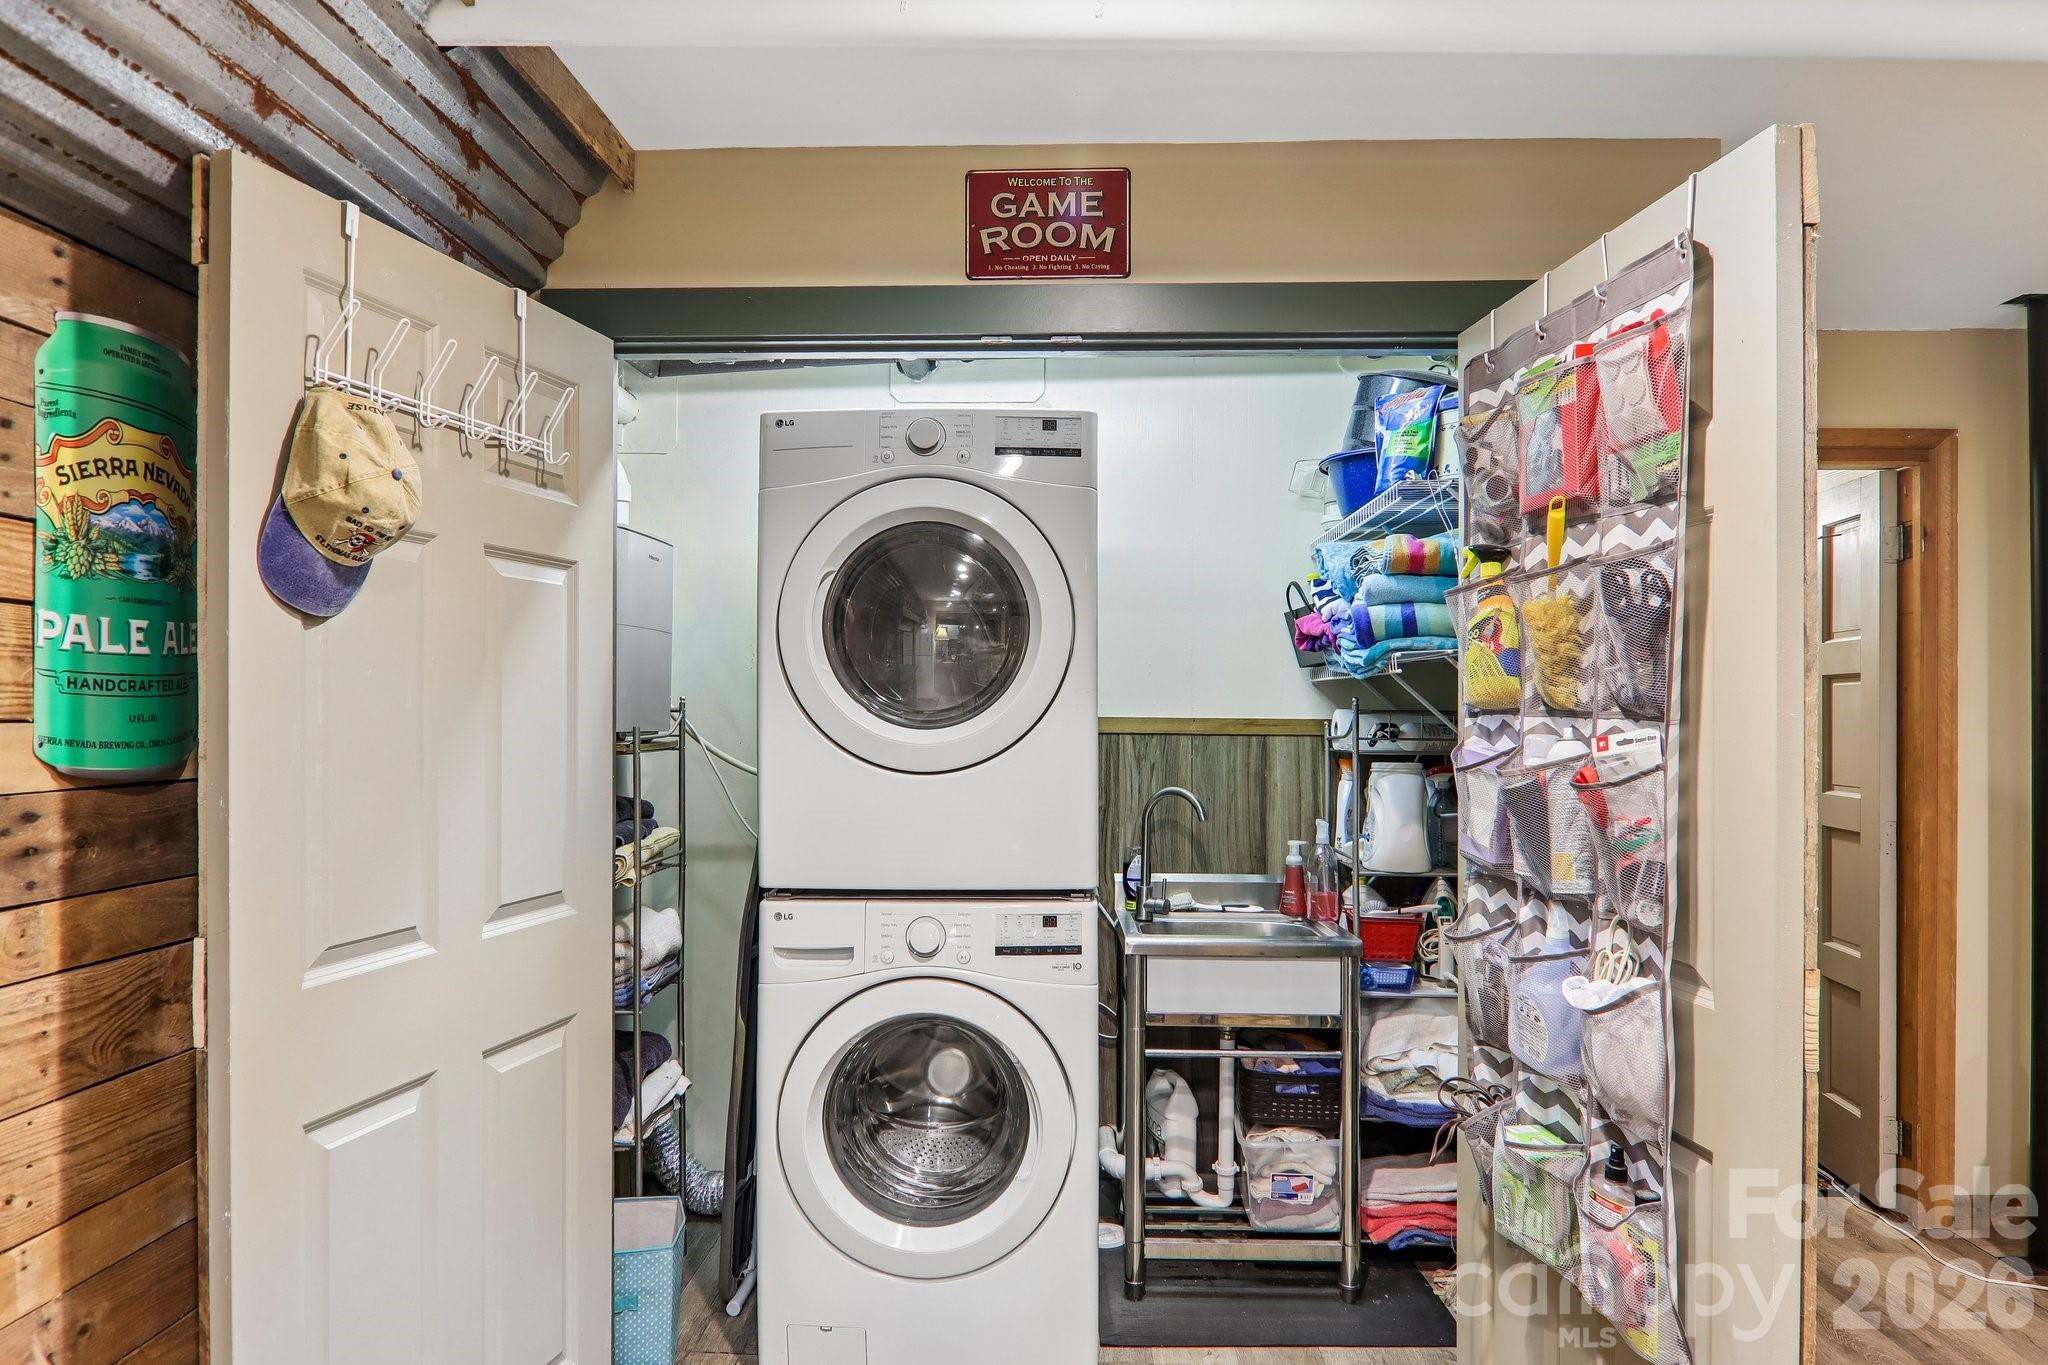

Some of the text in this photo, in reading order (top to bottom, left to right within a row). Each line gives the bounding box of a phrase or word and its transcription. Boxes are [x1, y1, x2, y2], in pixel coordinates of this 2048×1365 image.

[1007, 176, 1093, 187] WELCOME TO THE
[990, 190, 1104, 218] GAME
[979, 221, 1116, 255] ROOM
[1003, 263, 1029, 271] Cheating
[1090, 263, 1110, 271] Crying
[1022, 254, 1077, 262] OPEN DAILY
[55, 455, 193, 511] SIERRA NEVADA
[36, 608, 198, 656] PALE ALE
[66, 675, 188, 693] HANDCRAFTED ALE
[64, 739, 97, 749] NEVADA
[98, 741, 134, 750] BREWING
